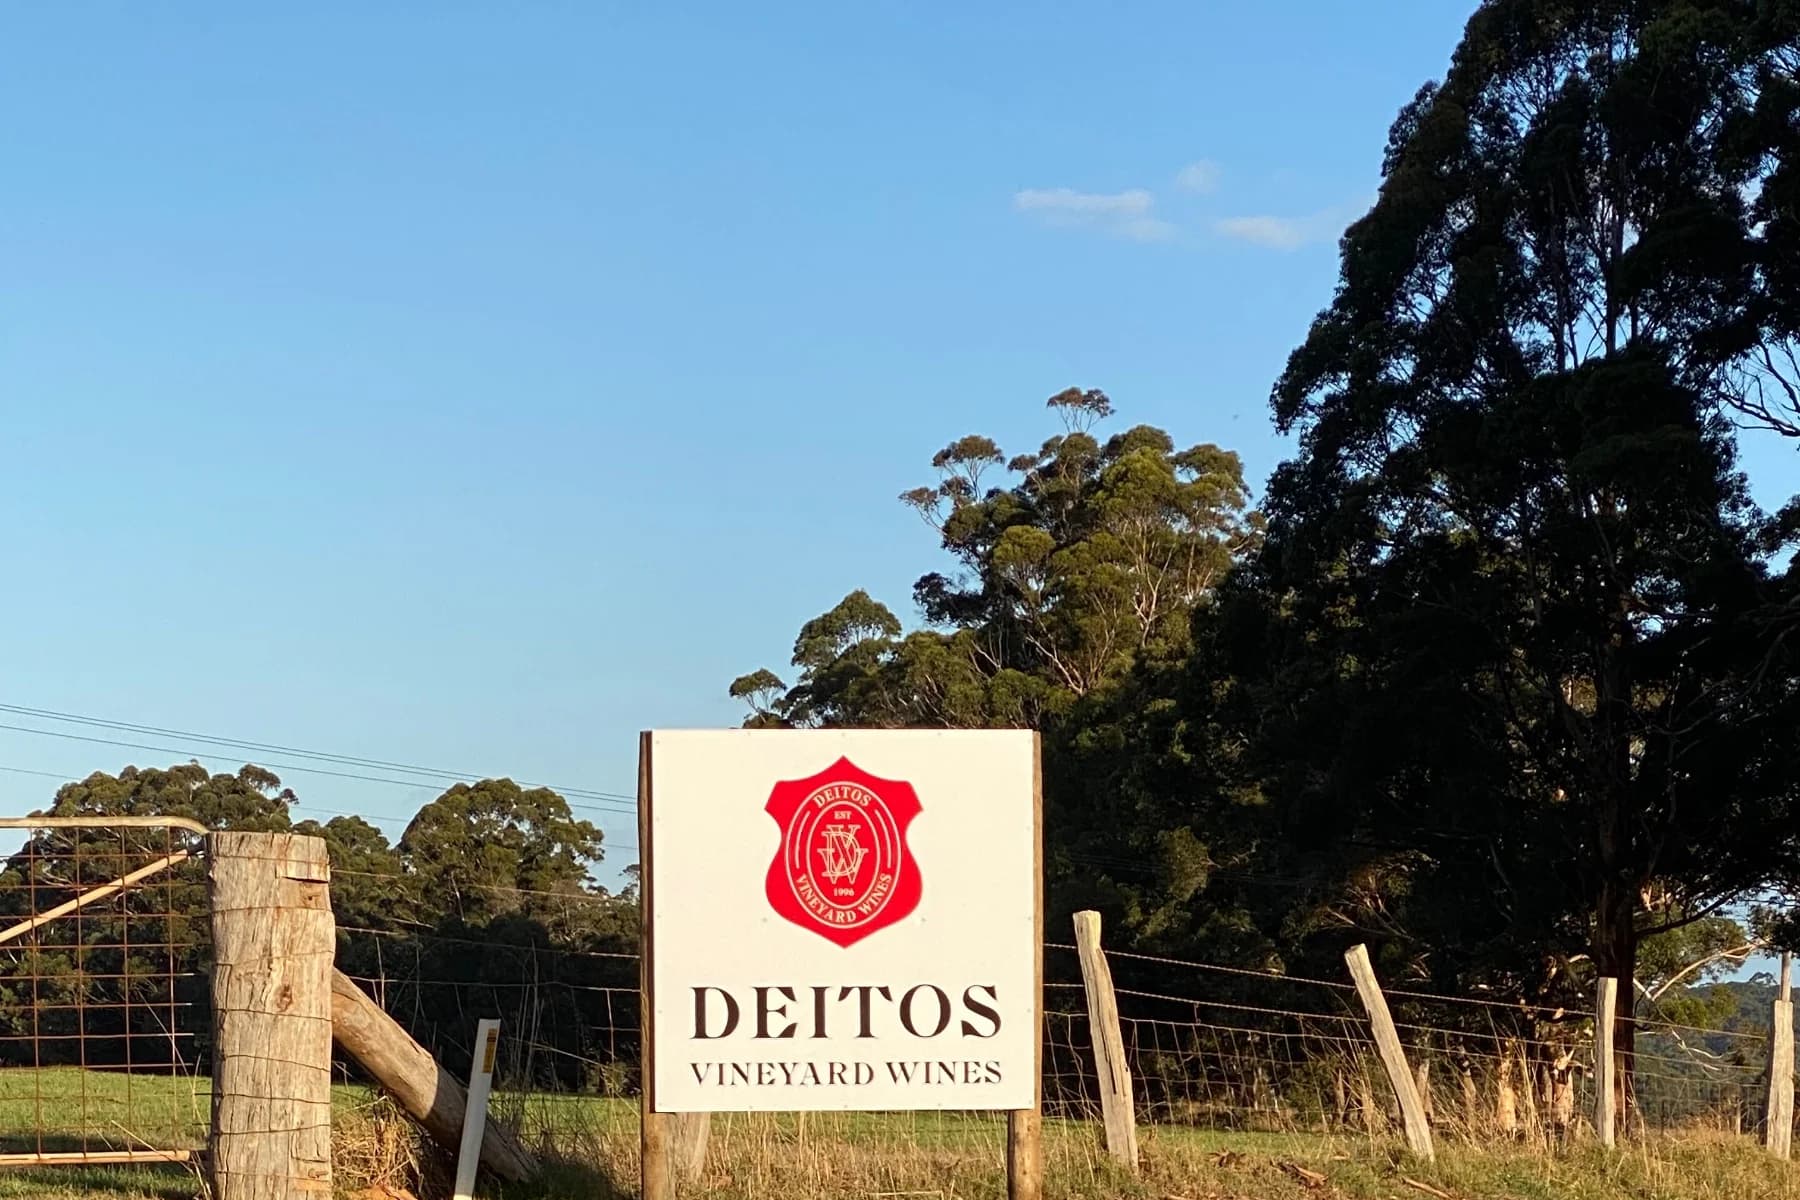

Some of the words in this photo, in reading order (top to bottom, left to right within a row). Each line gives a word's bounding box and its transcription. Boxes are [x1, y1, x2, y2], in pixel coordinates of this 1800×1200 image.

[813, 786, 871, 808] DEITOS
[834, 811, 852, 820] EST
[796, 873, 857, 923] VINEYARD
[858, 873, 893, 915] WINES
[833, 887, 855, 897] 1996
[690, 984, 1002, 1039] DEITOS
[690, 1061, 875, 1086] VINEYARD
[886, 1060, 1002, 1085] WINES
